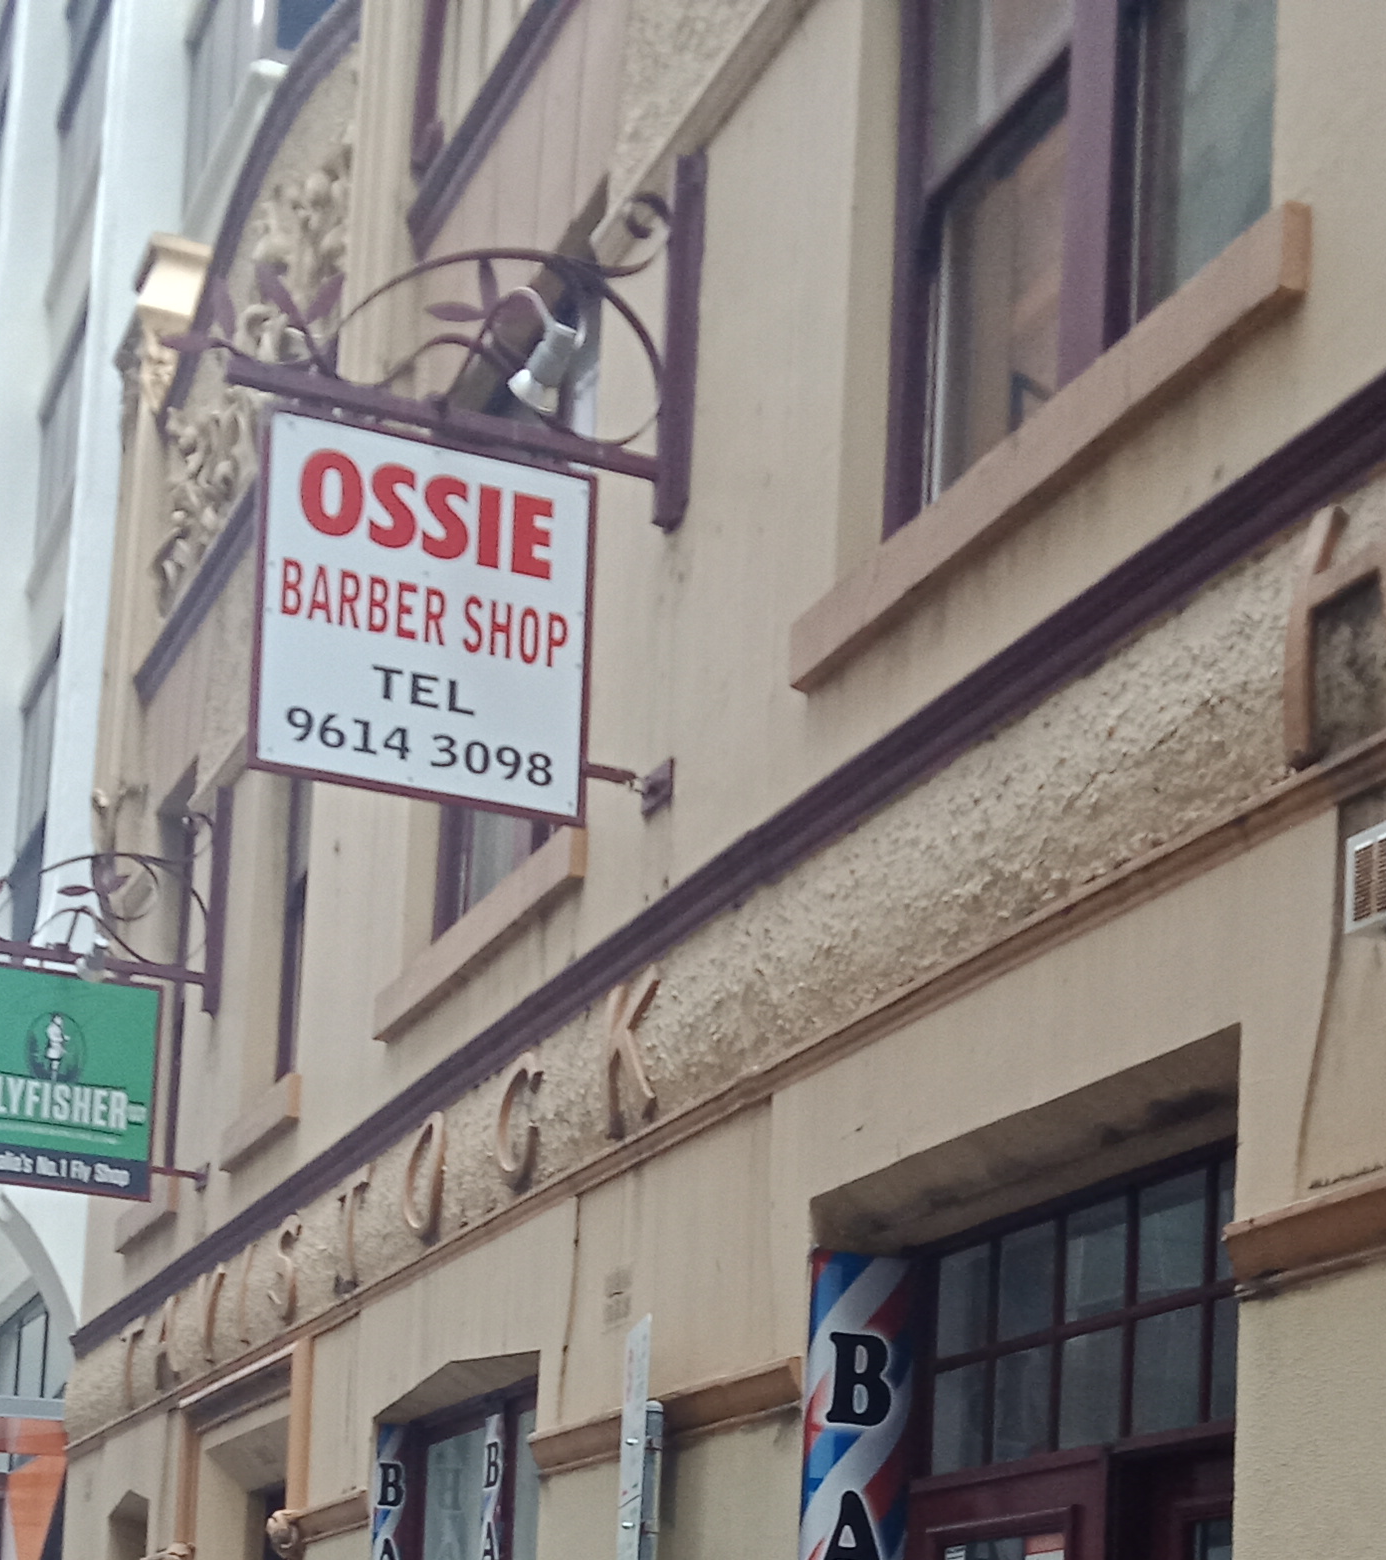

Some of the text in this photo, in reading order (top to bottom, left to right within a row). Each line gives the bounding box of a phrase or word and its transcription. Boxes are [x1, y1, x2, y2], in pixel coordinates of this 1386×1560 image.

[299, 448, 554, 580] OSSIE
[280, 557, 569, 668] BARBER SHOP
[372, 664, 475, 717] TEL
[286, 706, 554, 788] 9614 3098
[70, 1159, 93, 1184] Fly
[93, 1162, 131, 1188] Shop
